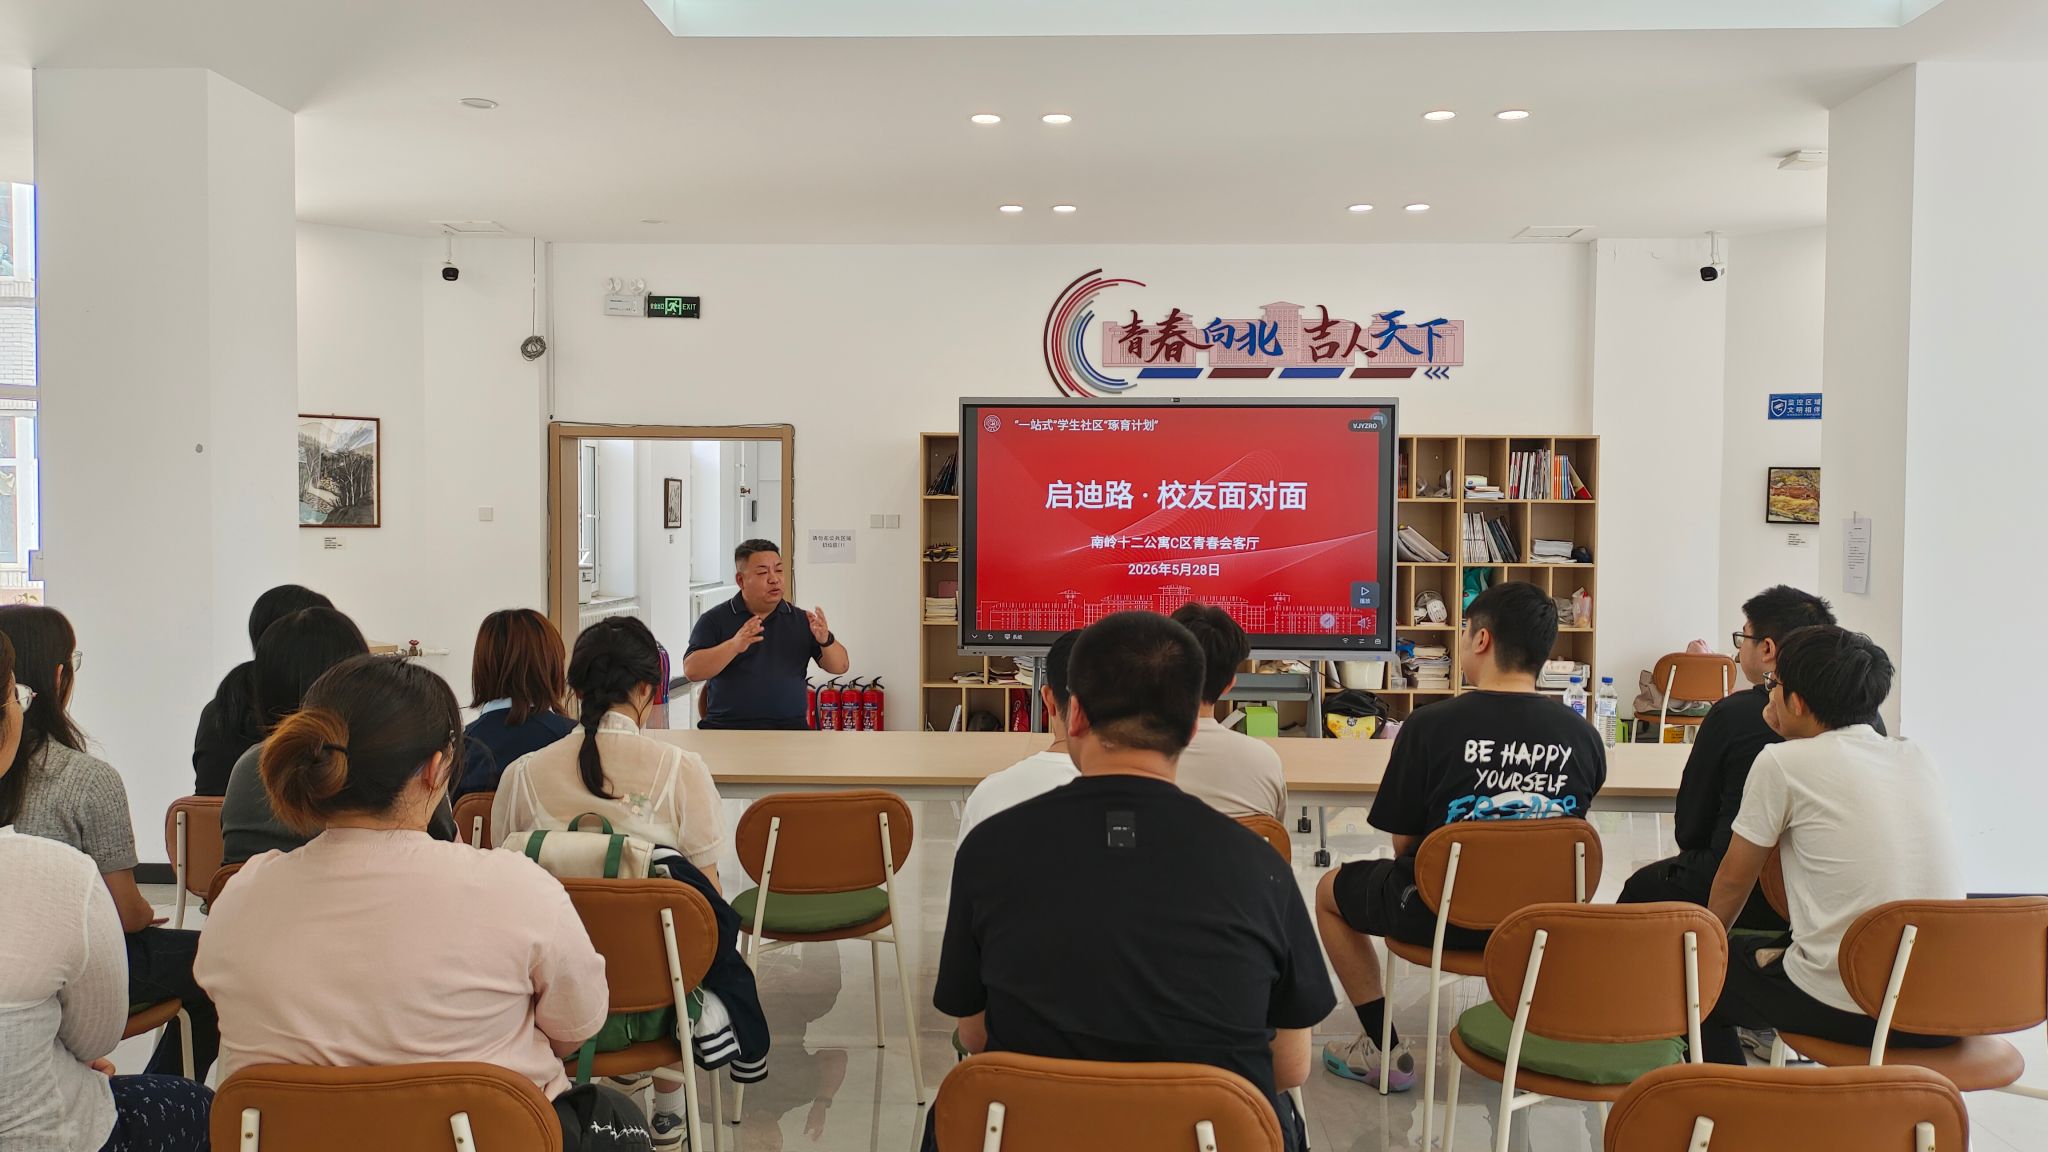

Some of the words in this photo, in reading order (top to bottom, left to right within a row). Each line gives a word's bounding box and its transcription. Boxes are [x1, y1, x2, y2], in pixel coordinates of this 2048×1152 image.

[1118, 308, 1284, 363] 青春向北
[1304, 304, 1449, 363] 吉人天下
[1090, 535, 1260, 550] 南岭十二公寓C区青春会客厅
[1128, 563, 1220, 577] 2026年5月28日
[1464, 740, 1496, 763] BE
[1500, 741, 1573, 773] HAPPY
[1473, 768, 1569, 796] YOURSELF
